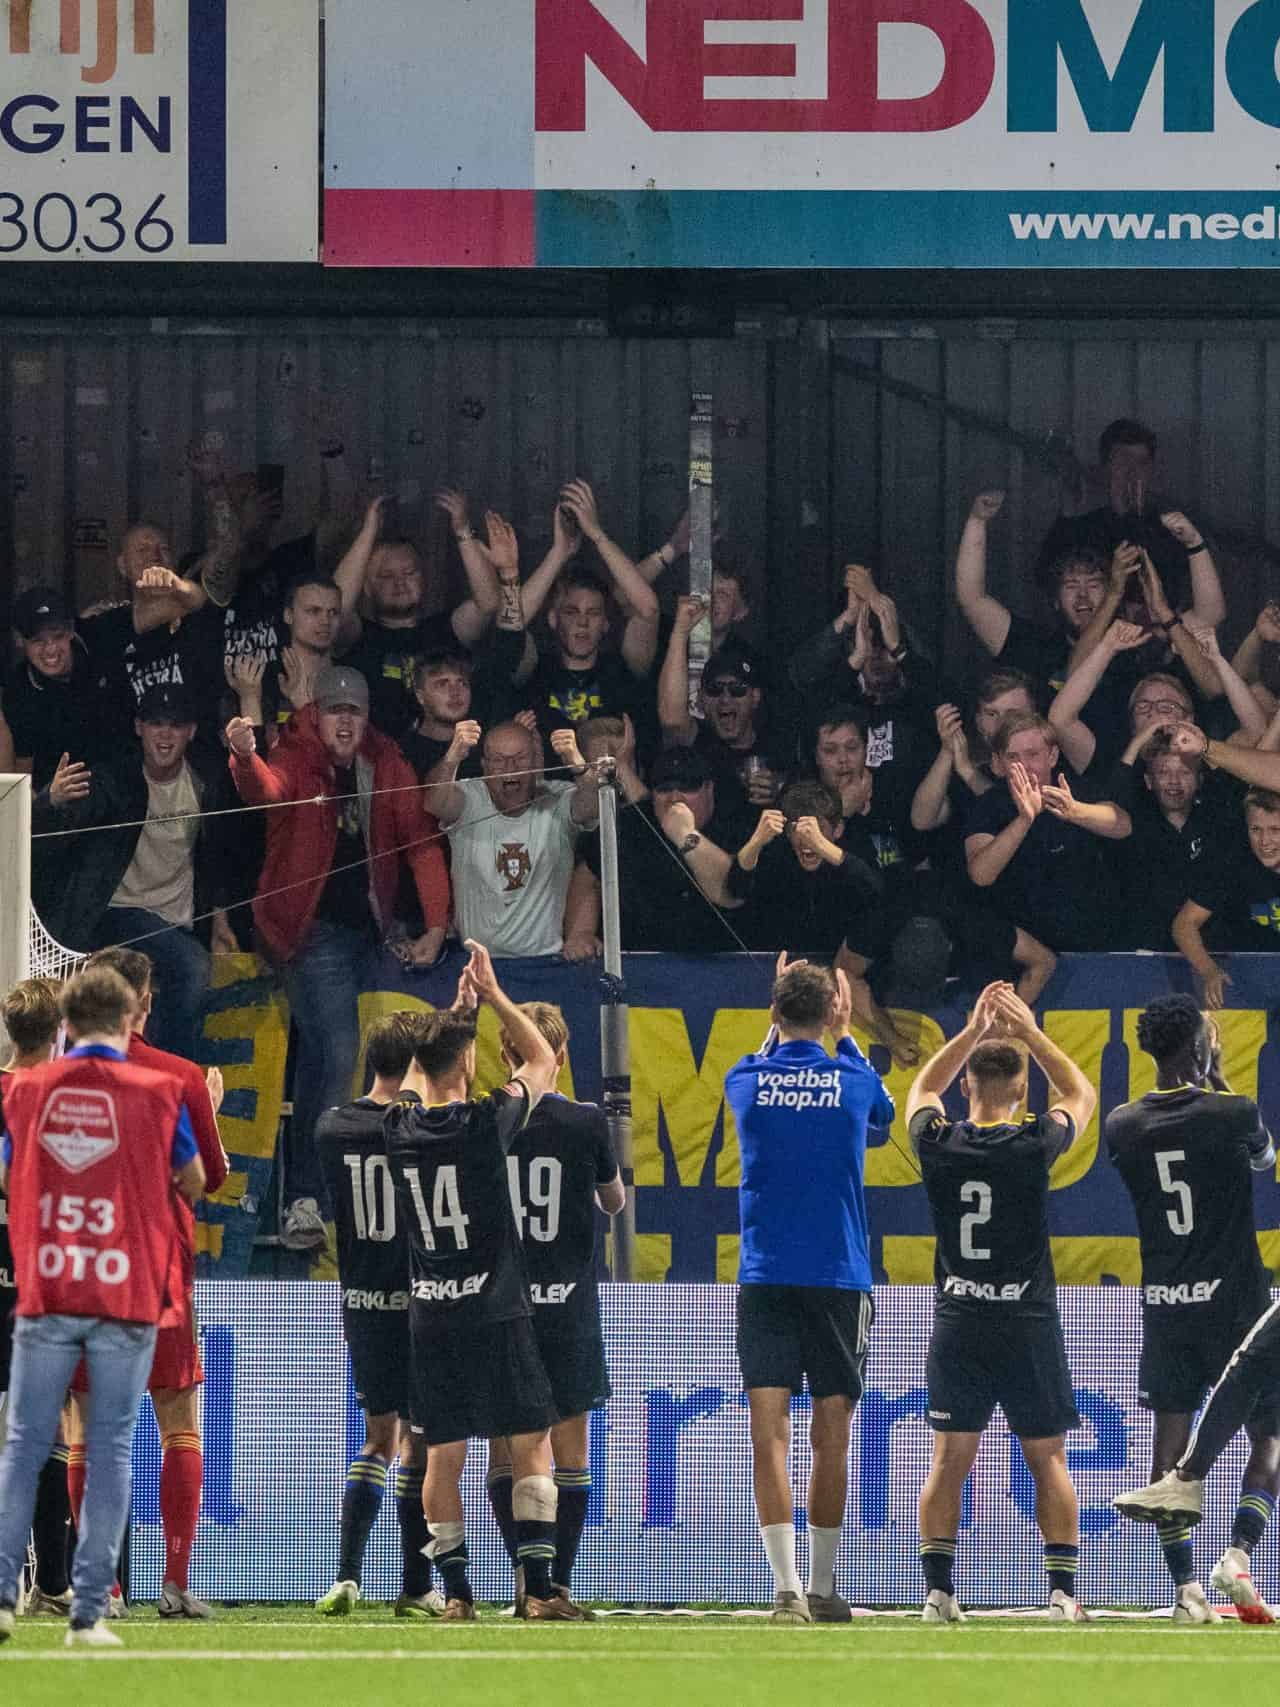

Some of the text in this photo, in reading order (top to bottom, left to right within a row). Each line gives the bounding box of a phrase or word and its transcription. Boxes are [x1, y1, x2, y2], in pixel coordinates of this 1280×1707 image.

[0, 94, 173, 154] GEN
[0, 191, 174, 254] 3036
[757, 1068, 841, 1087] voetbal
[757, 1086, 842, 1111] shop.nl
[40, 1193, 115, 1236] 153
[343, 1154, 397, 1242] 10
[403, 1164, 470, 1250] 14
[960, 1181, 992, 1260] 2
[1154, 1150, 1194, 1235] 5
[1145, 1278, 1222, 1305] ERKLEY
